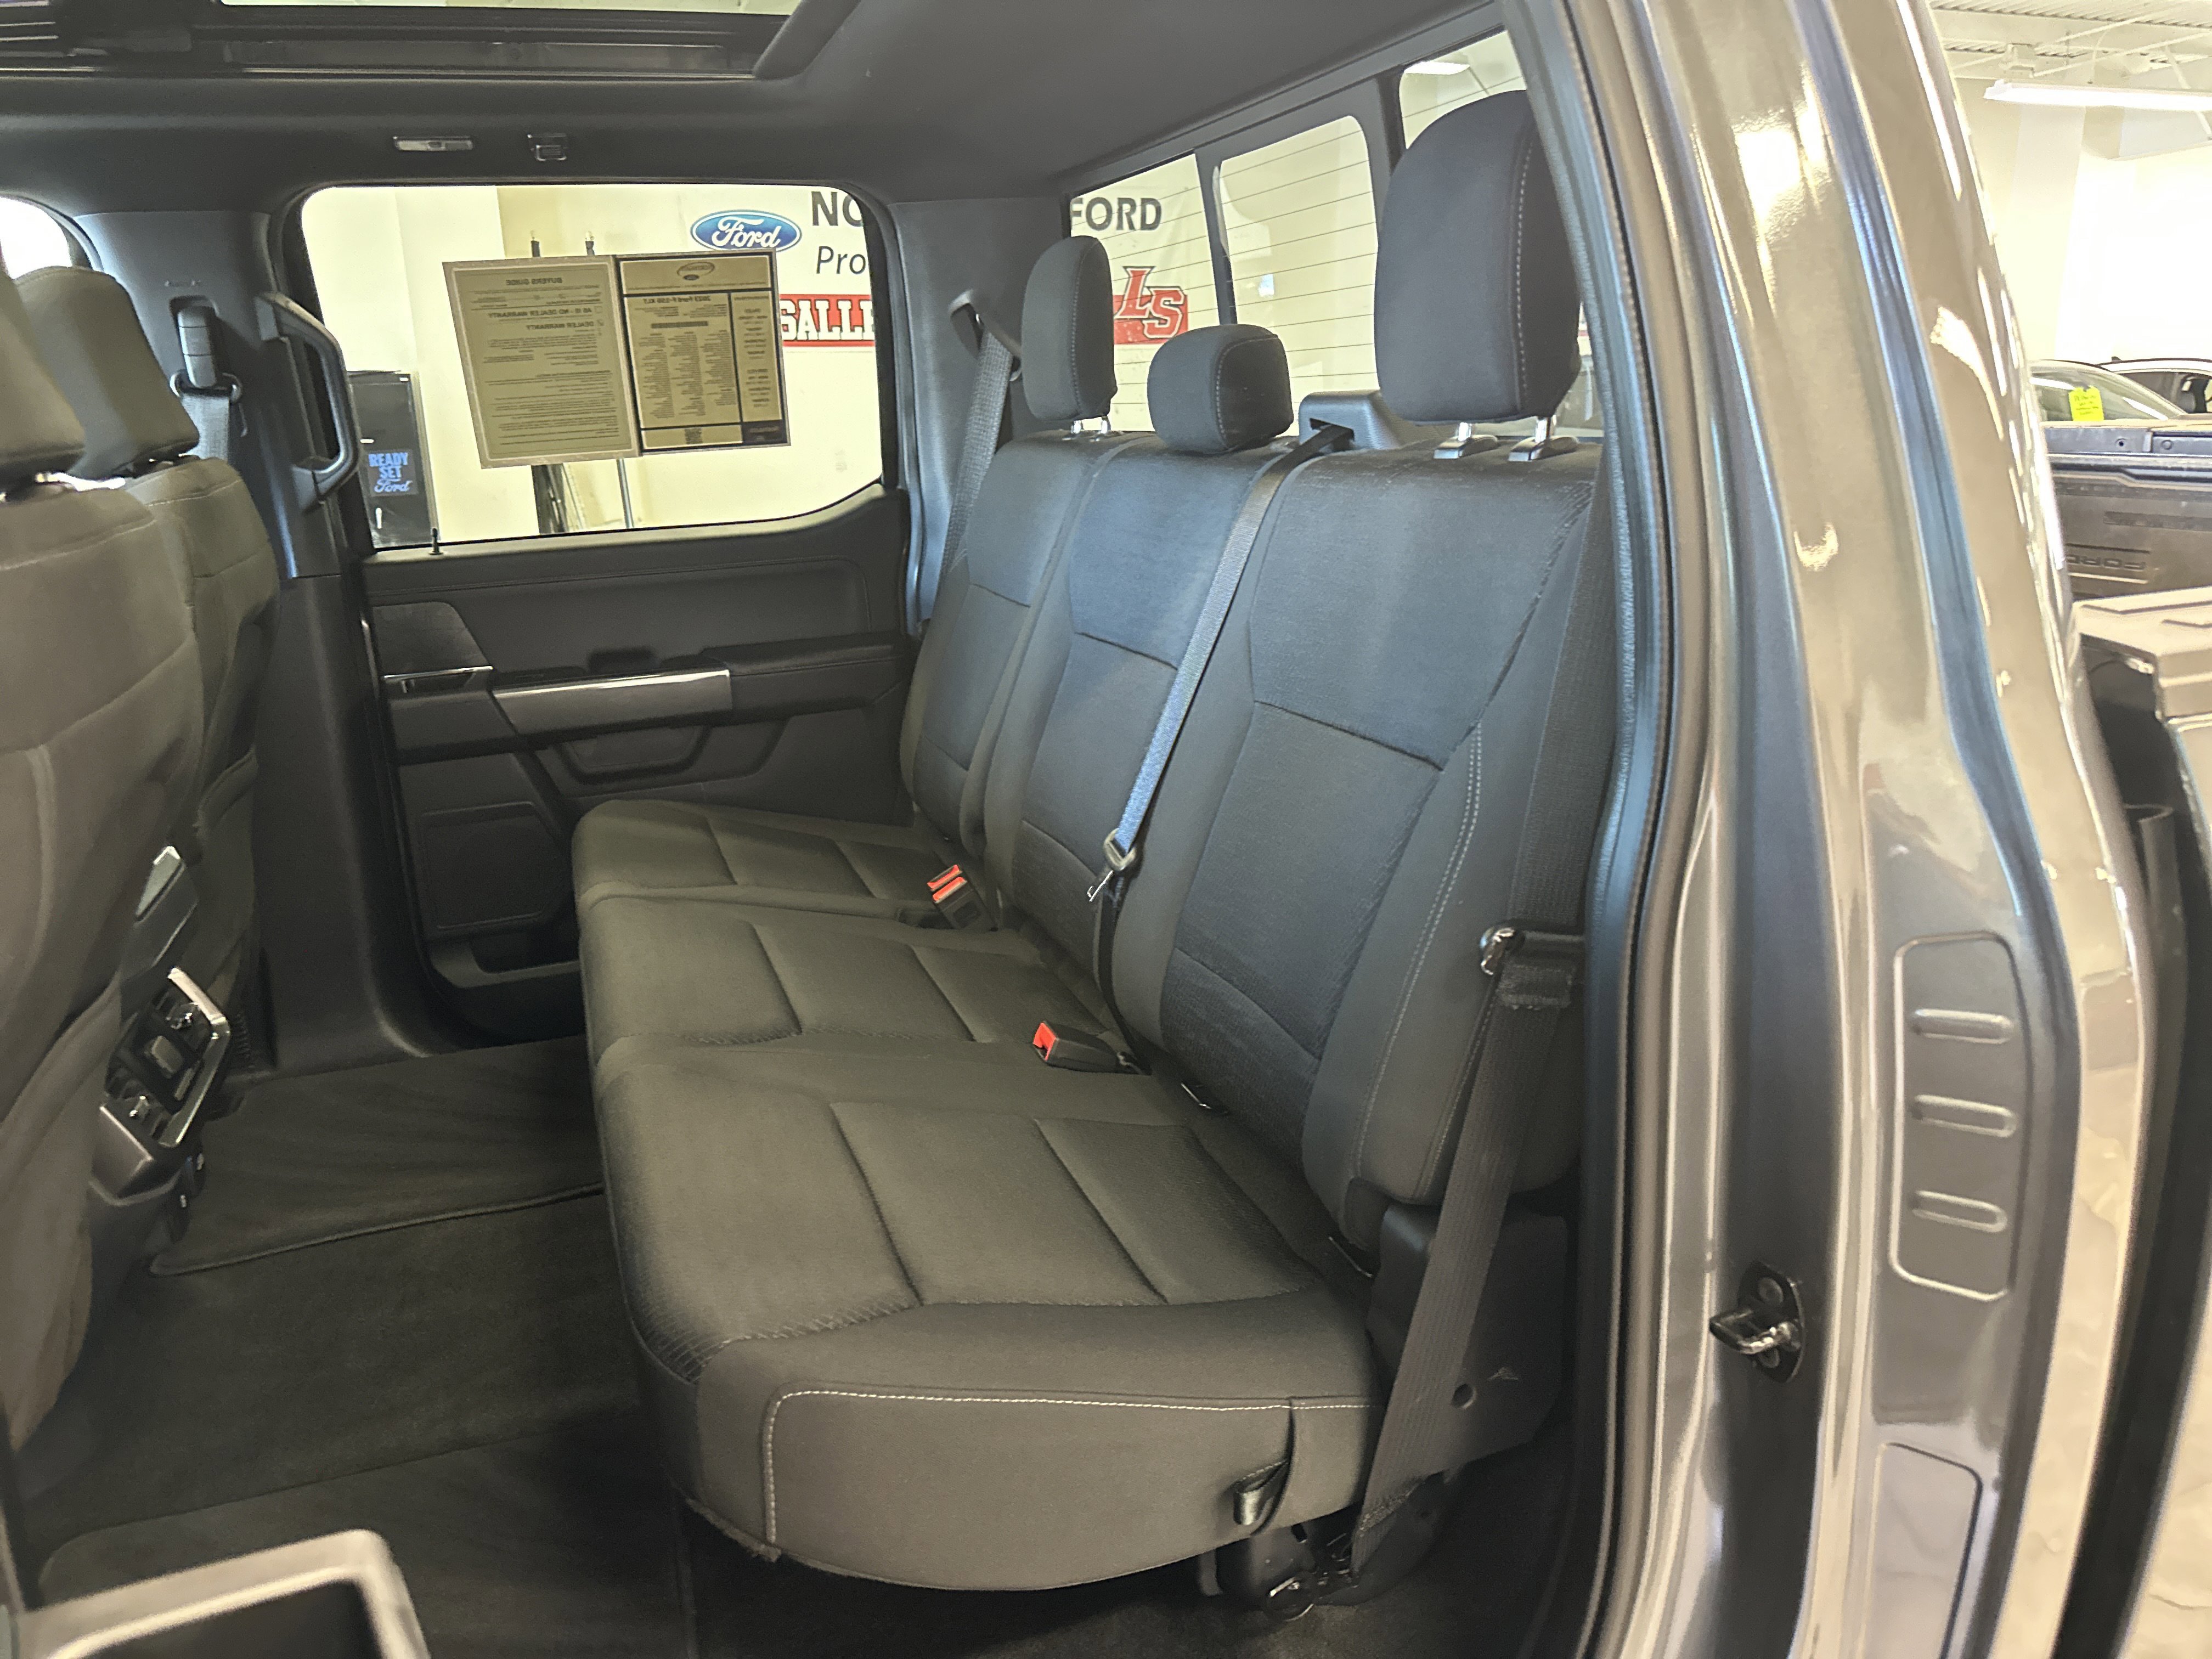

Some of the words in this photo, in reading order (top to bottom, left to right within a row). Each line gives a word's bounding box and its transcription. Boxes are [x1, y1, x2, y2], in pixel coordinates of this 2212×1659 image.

[712, 216, 781, 248] Ford
[816, 245, 866, 275] Pro
[368, 452, 408, 467] READY
[379, 465, 402, 479] SET
[374, 478, 414, 493] Ford
